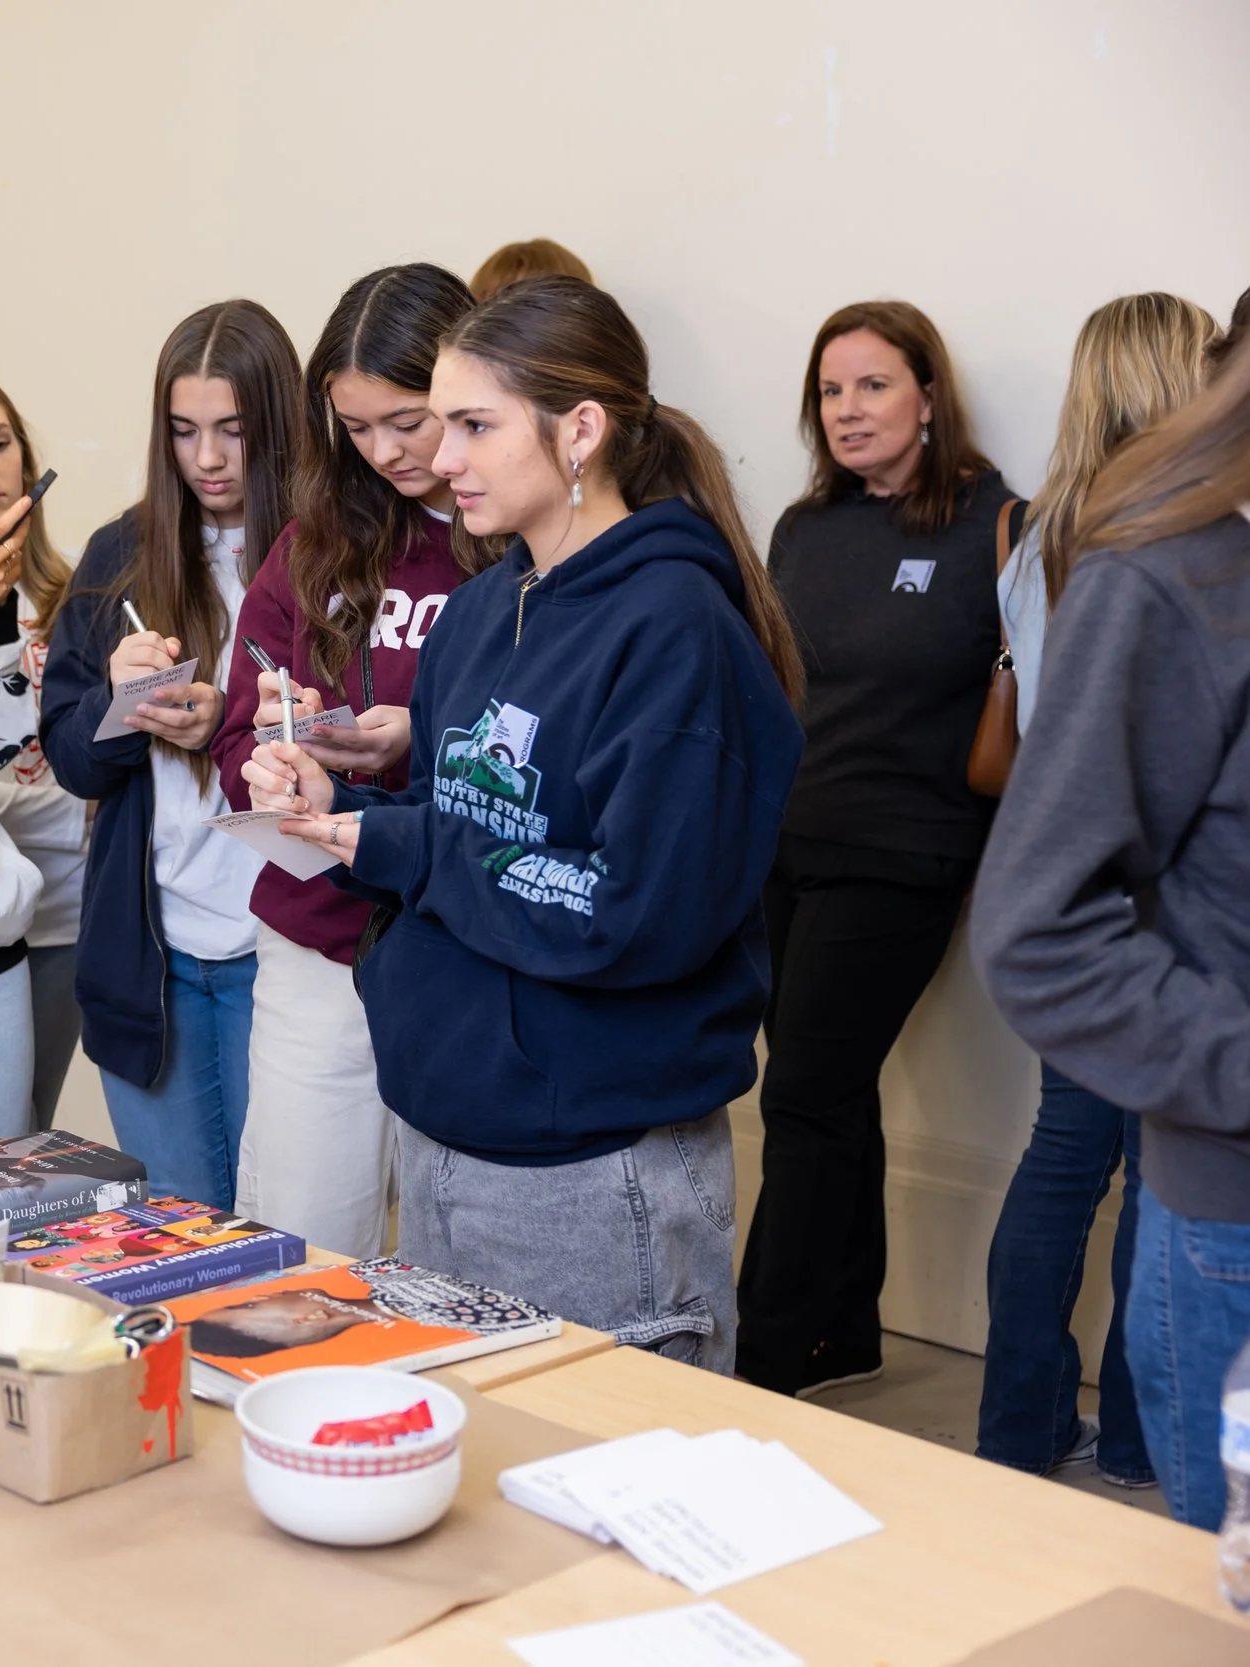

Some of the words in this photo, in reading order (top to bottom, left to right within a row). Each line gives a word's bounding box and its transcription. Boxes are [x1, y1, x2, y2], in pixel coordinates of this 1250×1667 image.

[124, 686, 146, 696] YOU
[148, 674, 184, 690] FROM?
[126, 675, 162, 689] WHERE
[165, 666, 186, 678] ARE
[265, 720, 310, 736] WHRE
[314, 713, 338, 724] ARE
[493, 797, 546, 831] STATE
[2, 1198, 68, 1221] Daughters
[71, 1190, 86, 1205] of
[157, 1231, 286, 1267] Revolutionary
[77, 1264, 155, 1285] Women
[112, 1274, 195, 1303] Revolutionary
[196, 1262, 241, 1283] Women
